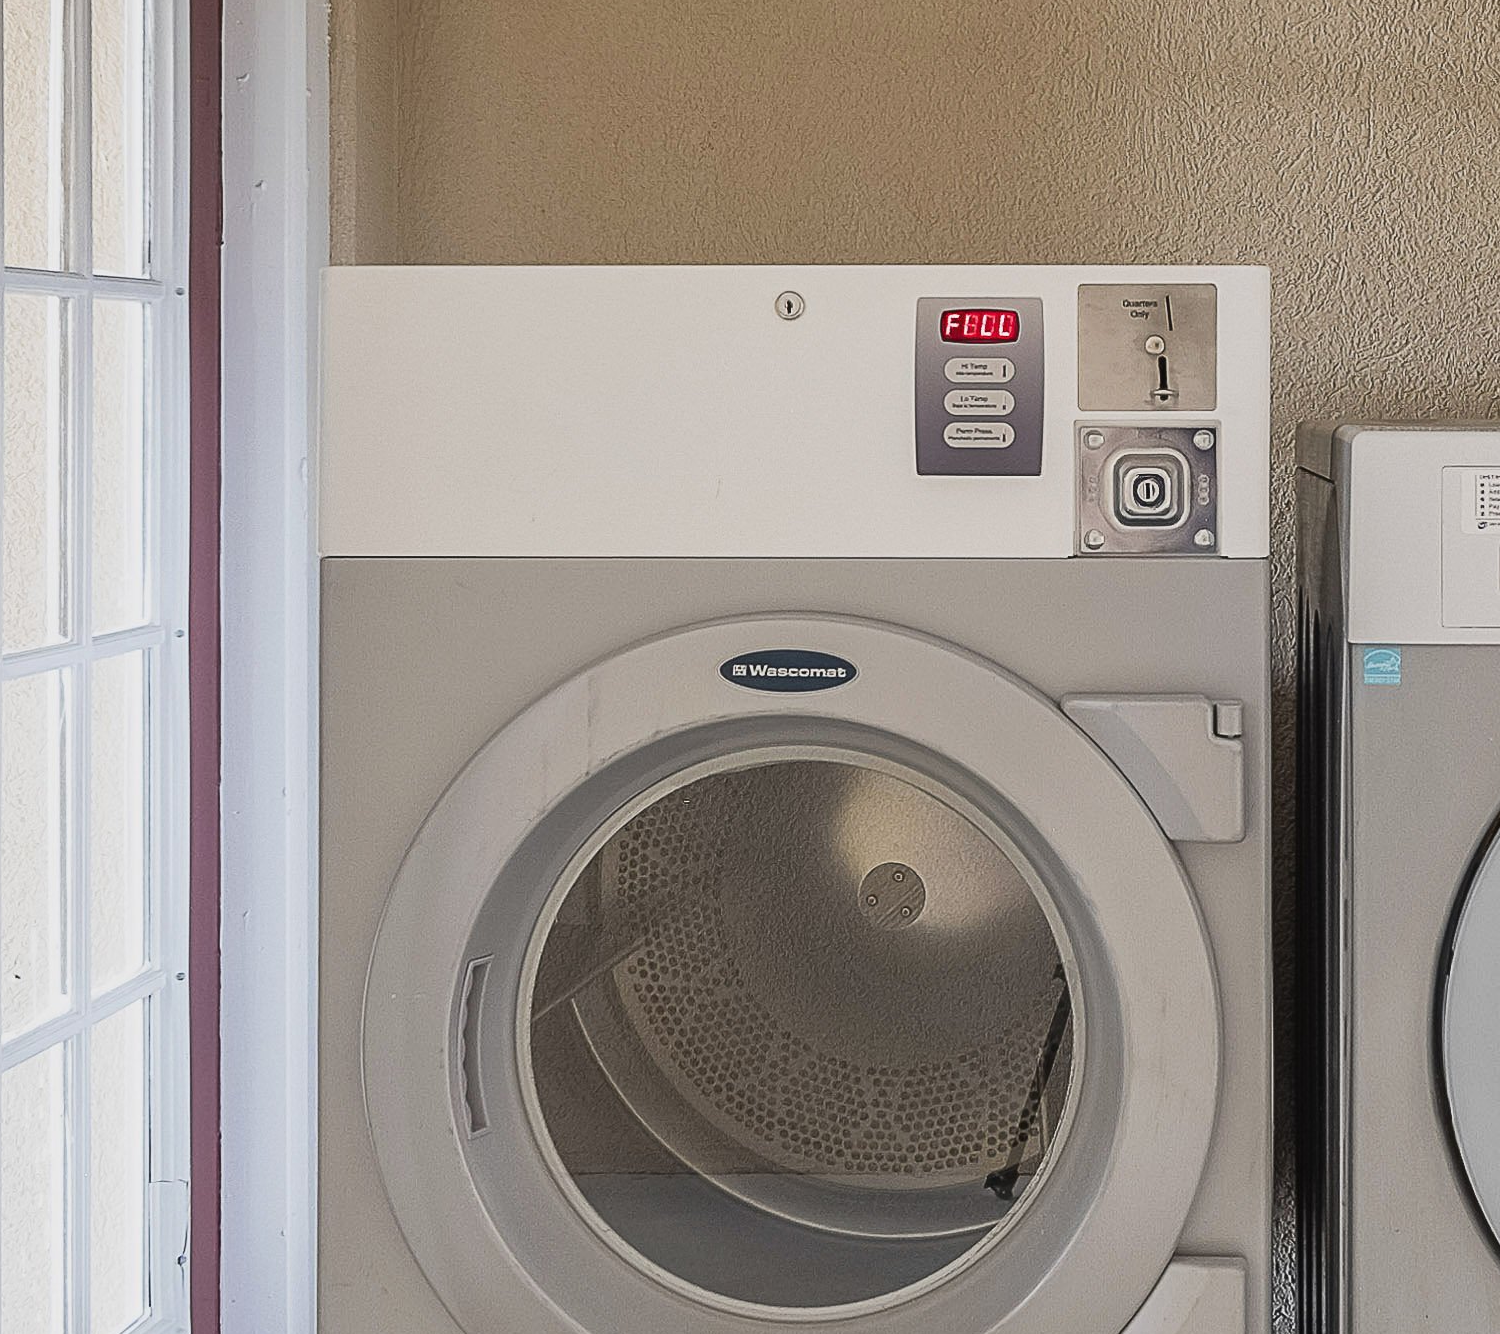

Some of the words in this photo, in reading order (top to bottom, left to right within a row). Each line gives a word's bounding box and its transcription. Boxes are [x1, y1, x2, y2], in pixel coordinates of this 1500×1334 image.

[1122, 299, 1158, 308] Quarters
[1130, 310, 1150, 320] Only
[748, 664, 847, 678] Wascomat
